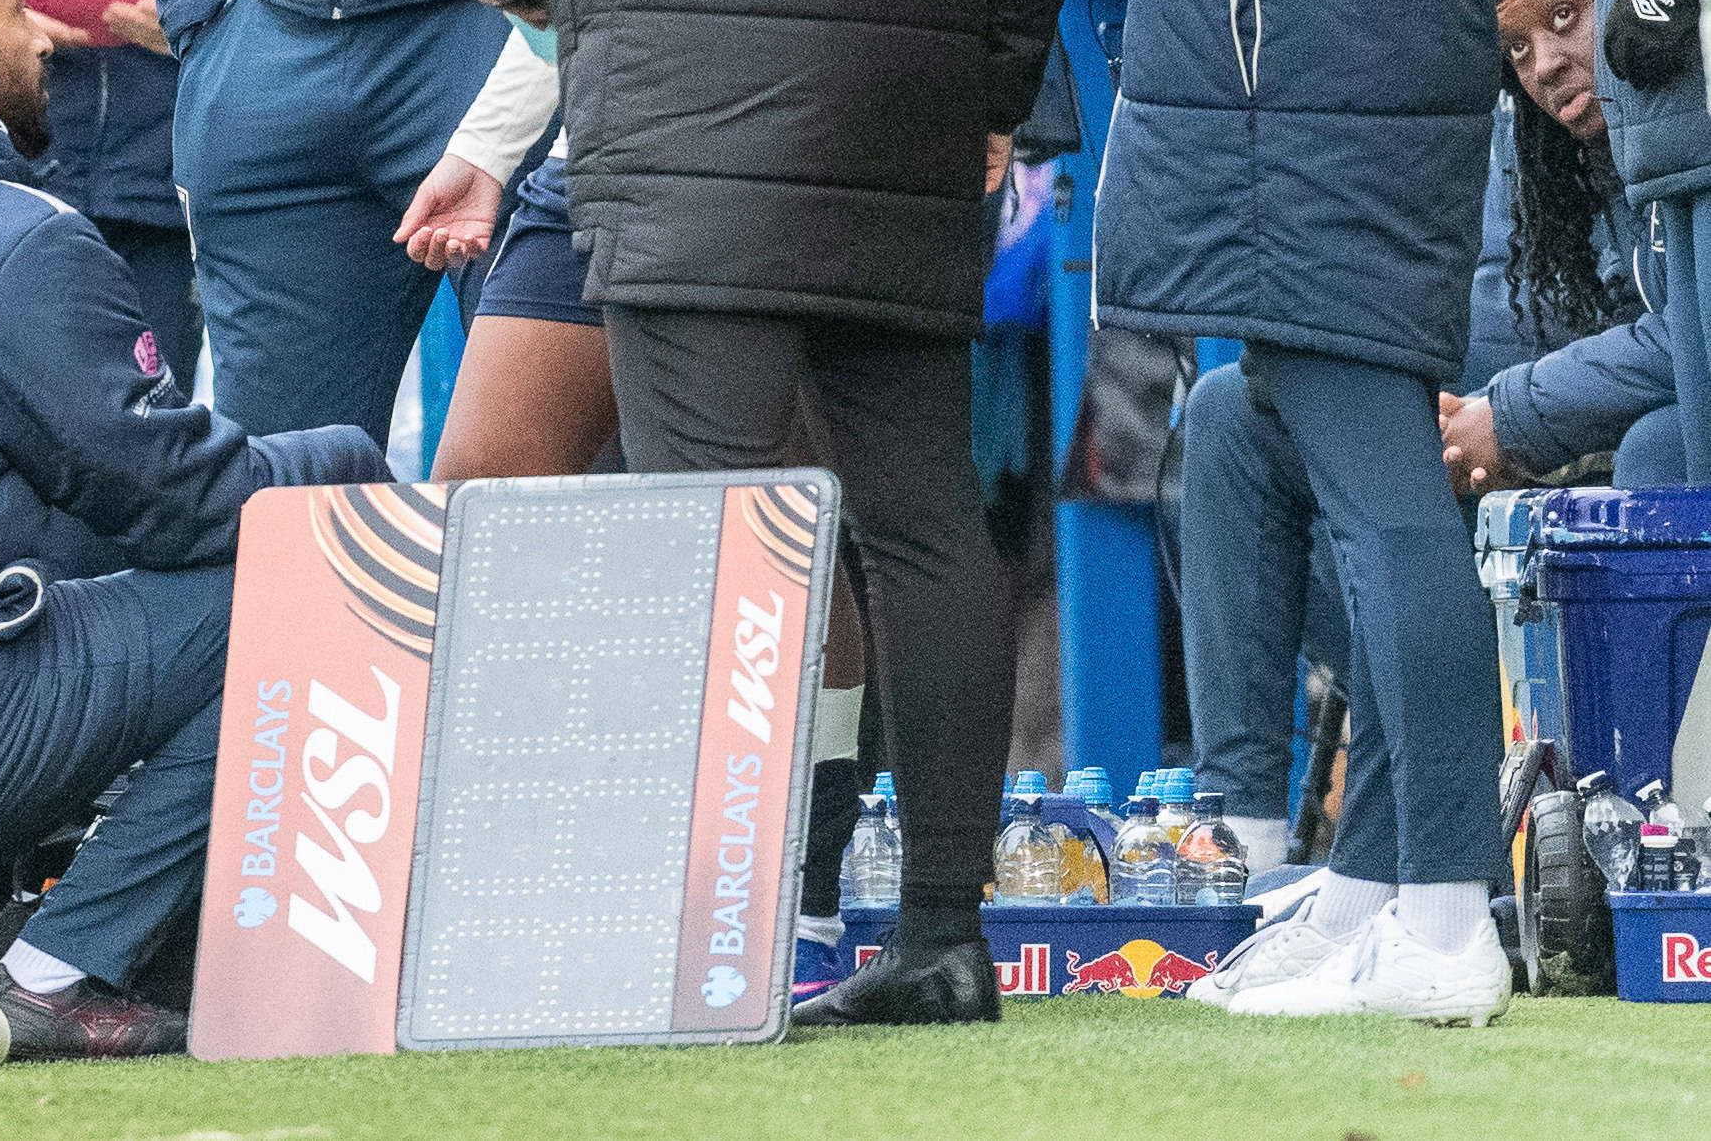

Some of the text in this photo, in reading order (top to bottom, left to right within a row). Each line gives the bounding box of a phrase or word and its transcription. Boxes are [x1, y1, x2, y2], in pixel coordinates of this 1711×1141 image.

[241, 679, 292, 877] BARCLAYS
[288, 664, 402, 985] WSL
[709, 589, 786, 957] BARCLAYS WSL
[993, 944, 1050, 994] ull
[1662, 932, 1711, 982] Re
